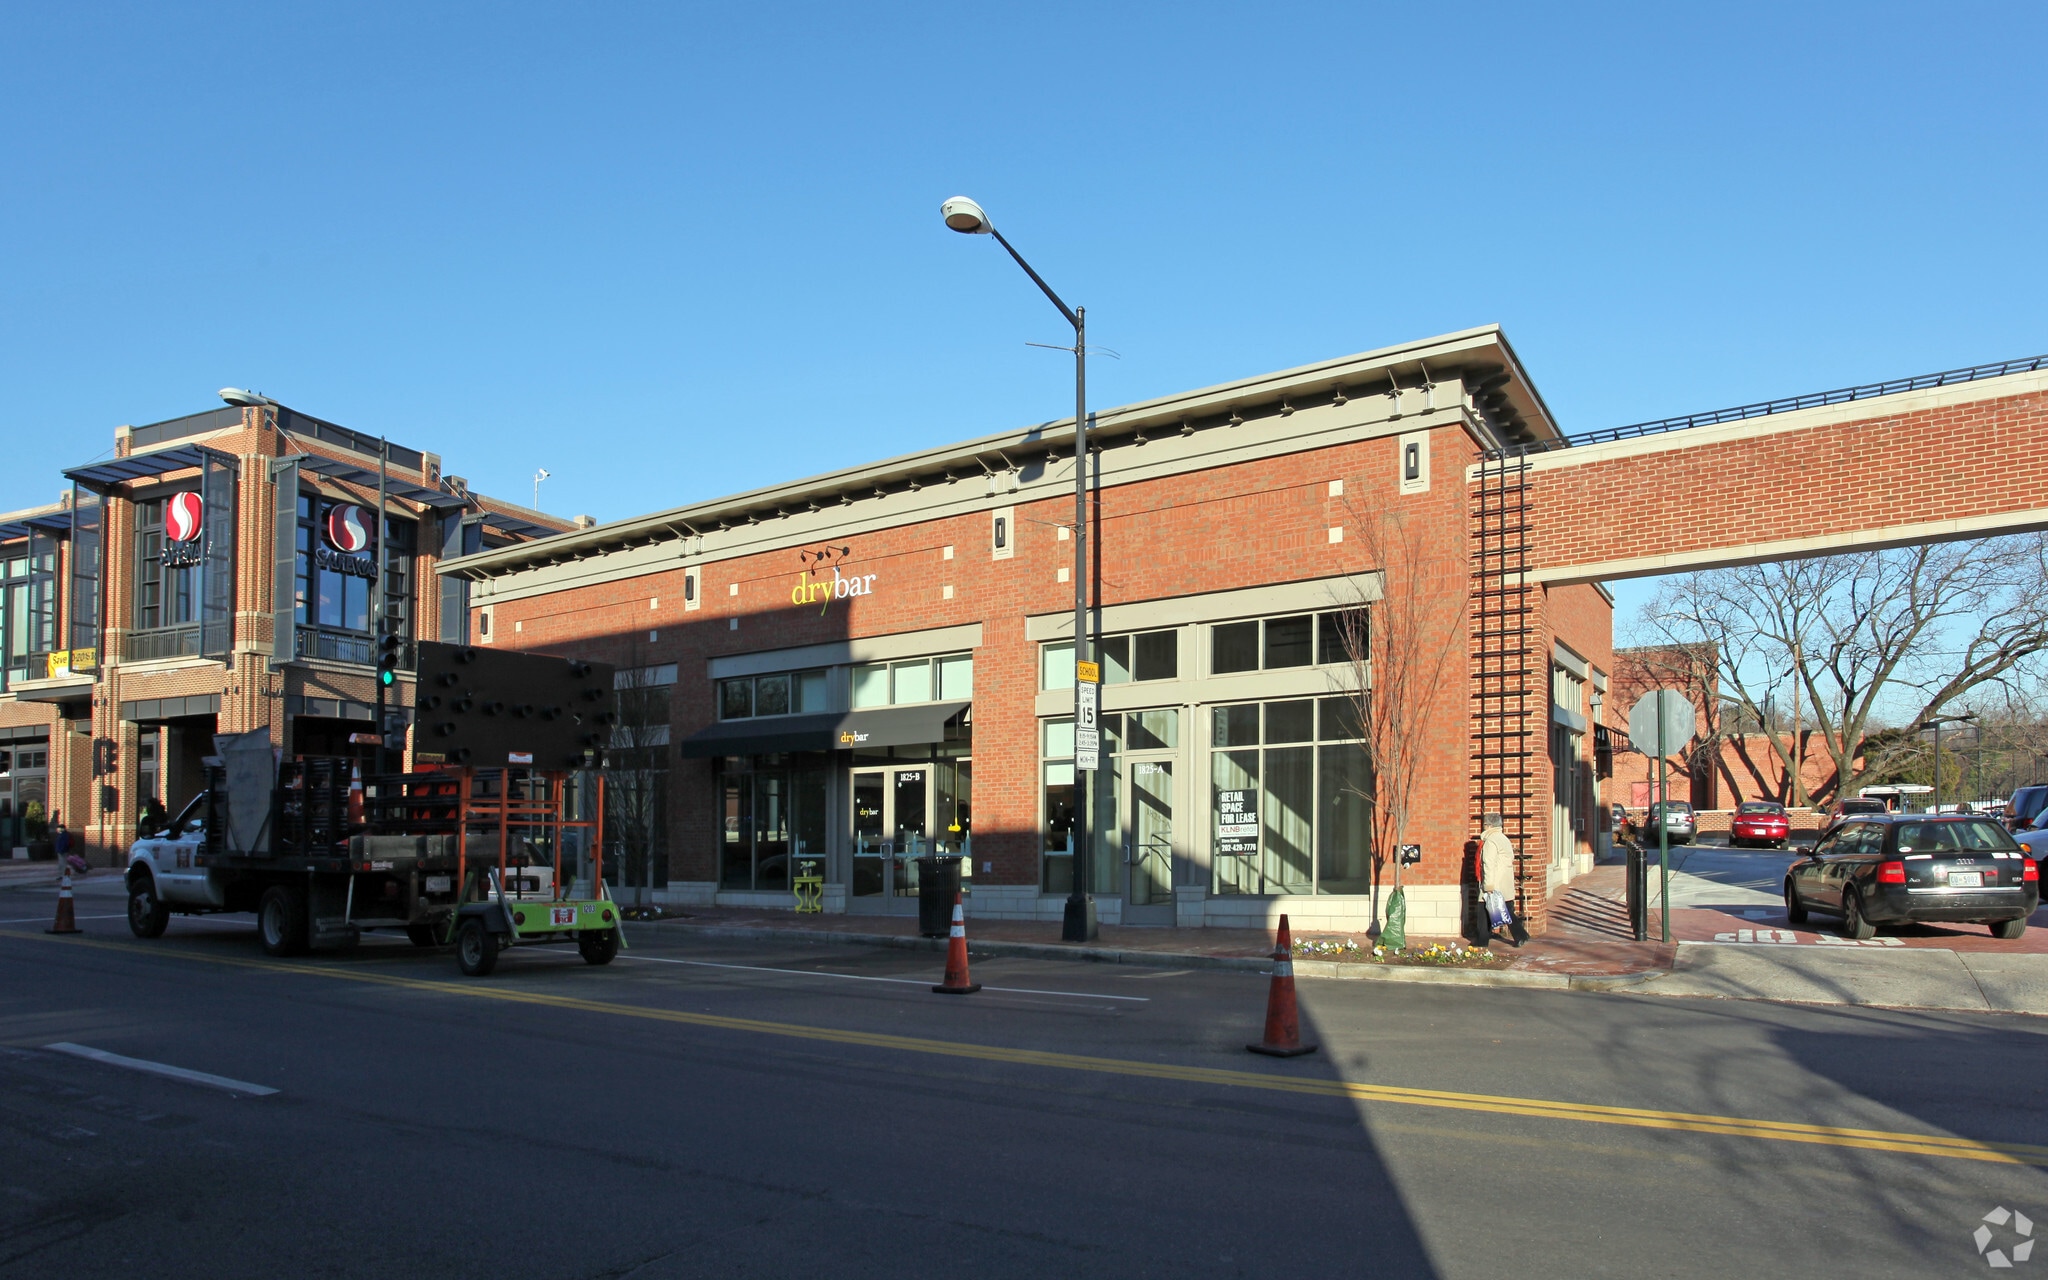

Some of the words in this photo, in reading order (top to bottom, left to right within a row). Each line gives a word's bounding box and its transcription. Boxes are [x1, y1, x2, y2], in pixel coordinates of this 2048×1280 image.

[315, 547, 379, 578] SAFEWA
[791, 566, 876, 616] drybar
[1079, 666, 1097, 678] SCHOOL
[1081, 686, 1095, 695] SPEED
[1082, 696, 1094, 704] LIMIT
[1082, 706, 1094, 724] 15
[840, 730, 869, 747] drybar
[1079, 756, 1096, 764] MON-FRI
[1139, 764, 1165, 775] 1825-A
[900, 772, 920, 781] 1825-B
[1221, 791, 1244, 802] RETAIL
[860, 807, 879, 818] drybar
[1221, 802, 1243, 813] SPACE
[1221, 813, 1234, 824] FOR
[1236, 812, 1256, 823] LEASE
